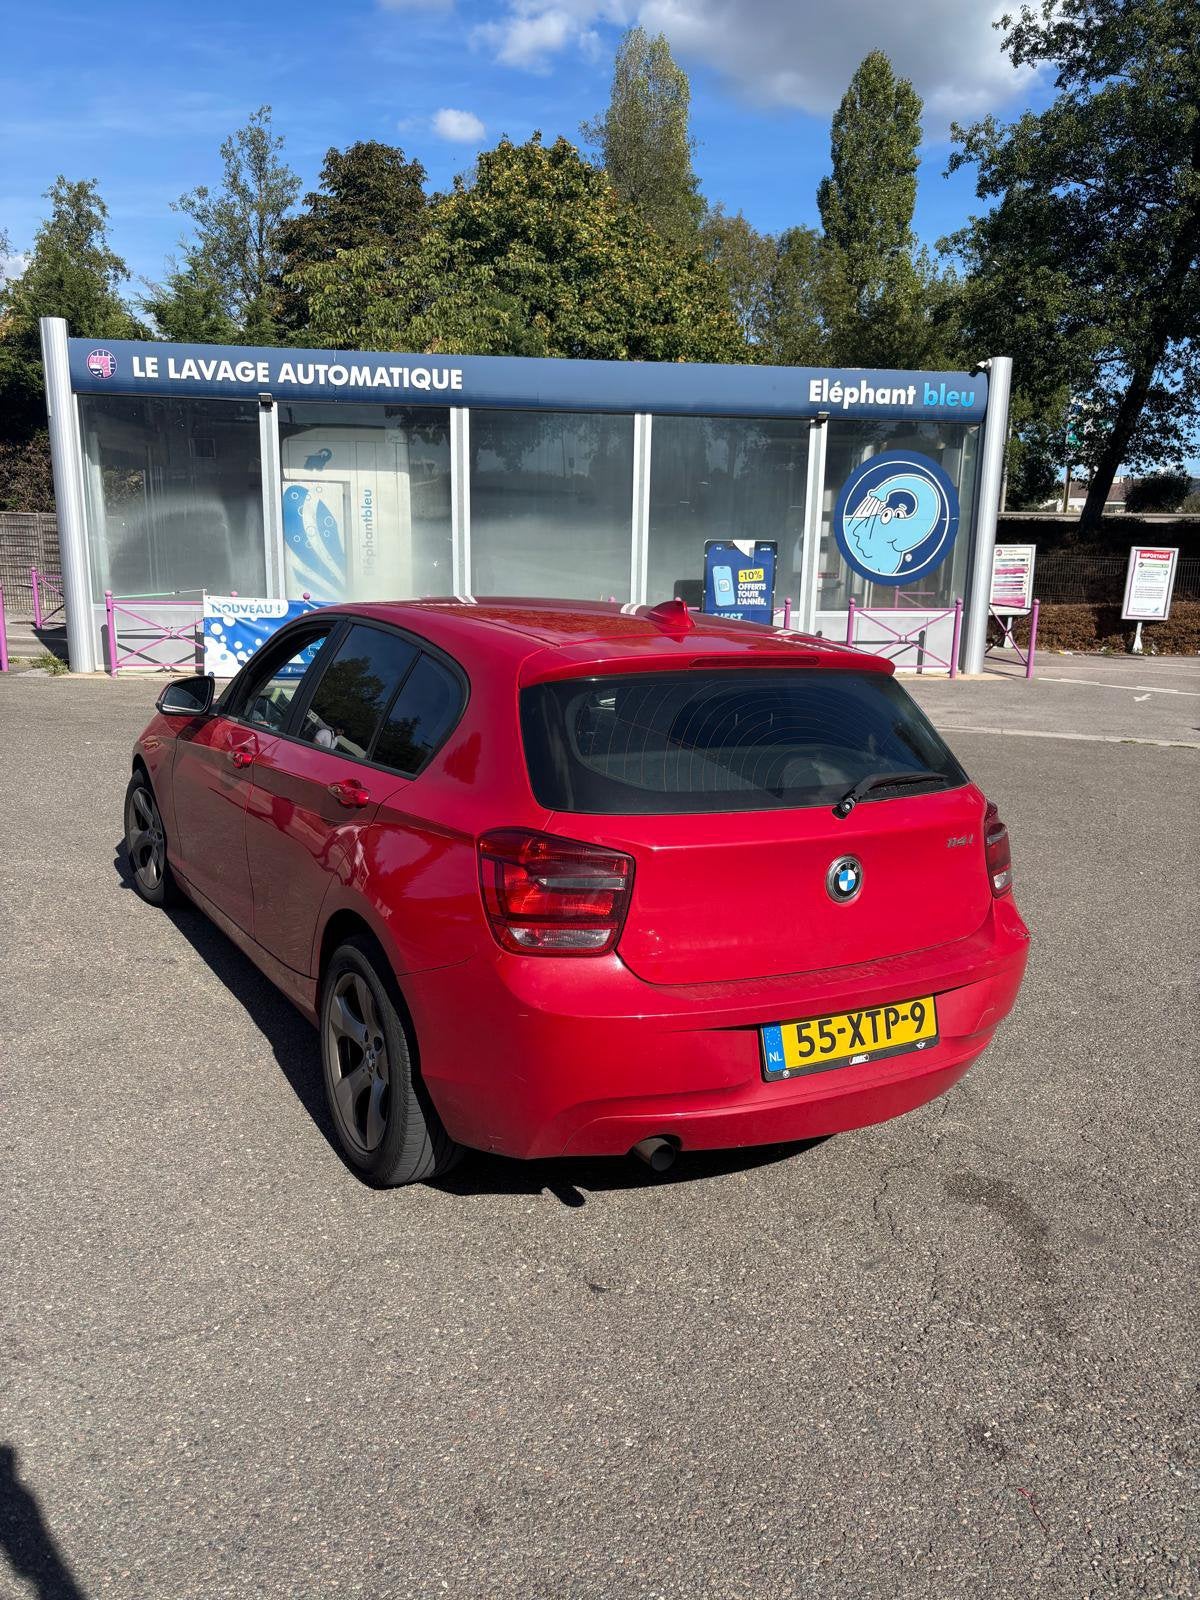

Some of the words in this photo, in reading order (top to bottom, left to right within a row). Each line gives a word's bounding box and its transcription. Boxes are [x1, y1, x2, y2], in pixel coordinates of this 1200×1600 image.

[132, 356, 159, 379] LE
[167, 357, 270, 383] LAVAGE
[277, 362, 463, 391] AUTOMATIQUE
[809, 378, 916, 410] Eléphant
[923, 382, 975, 408] bleu
[1140, 552, 1170, 560] IMPORTANT
[740, 571, 762, 580] -10%
[211, 604, 273, 614] NOUVEAU
[277, 604, 281, 614] !
[796, 1001, 926, 1058] 55-XTP-9
[768, 1051, 783, 1063] NL
